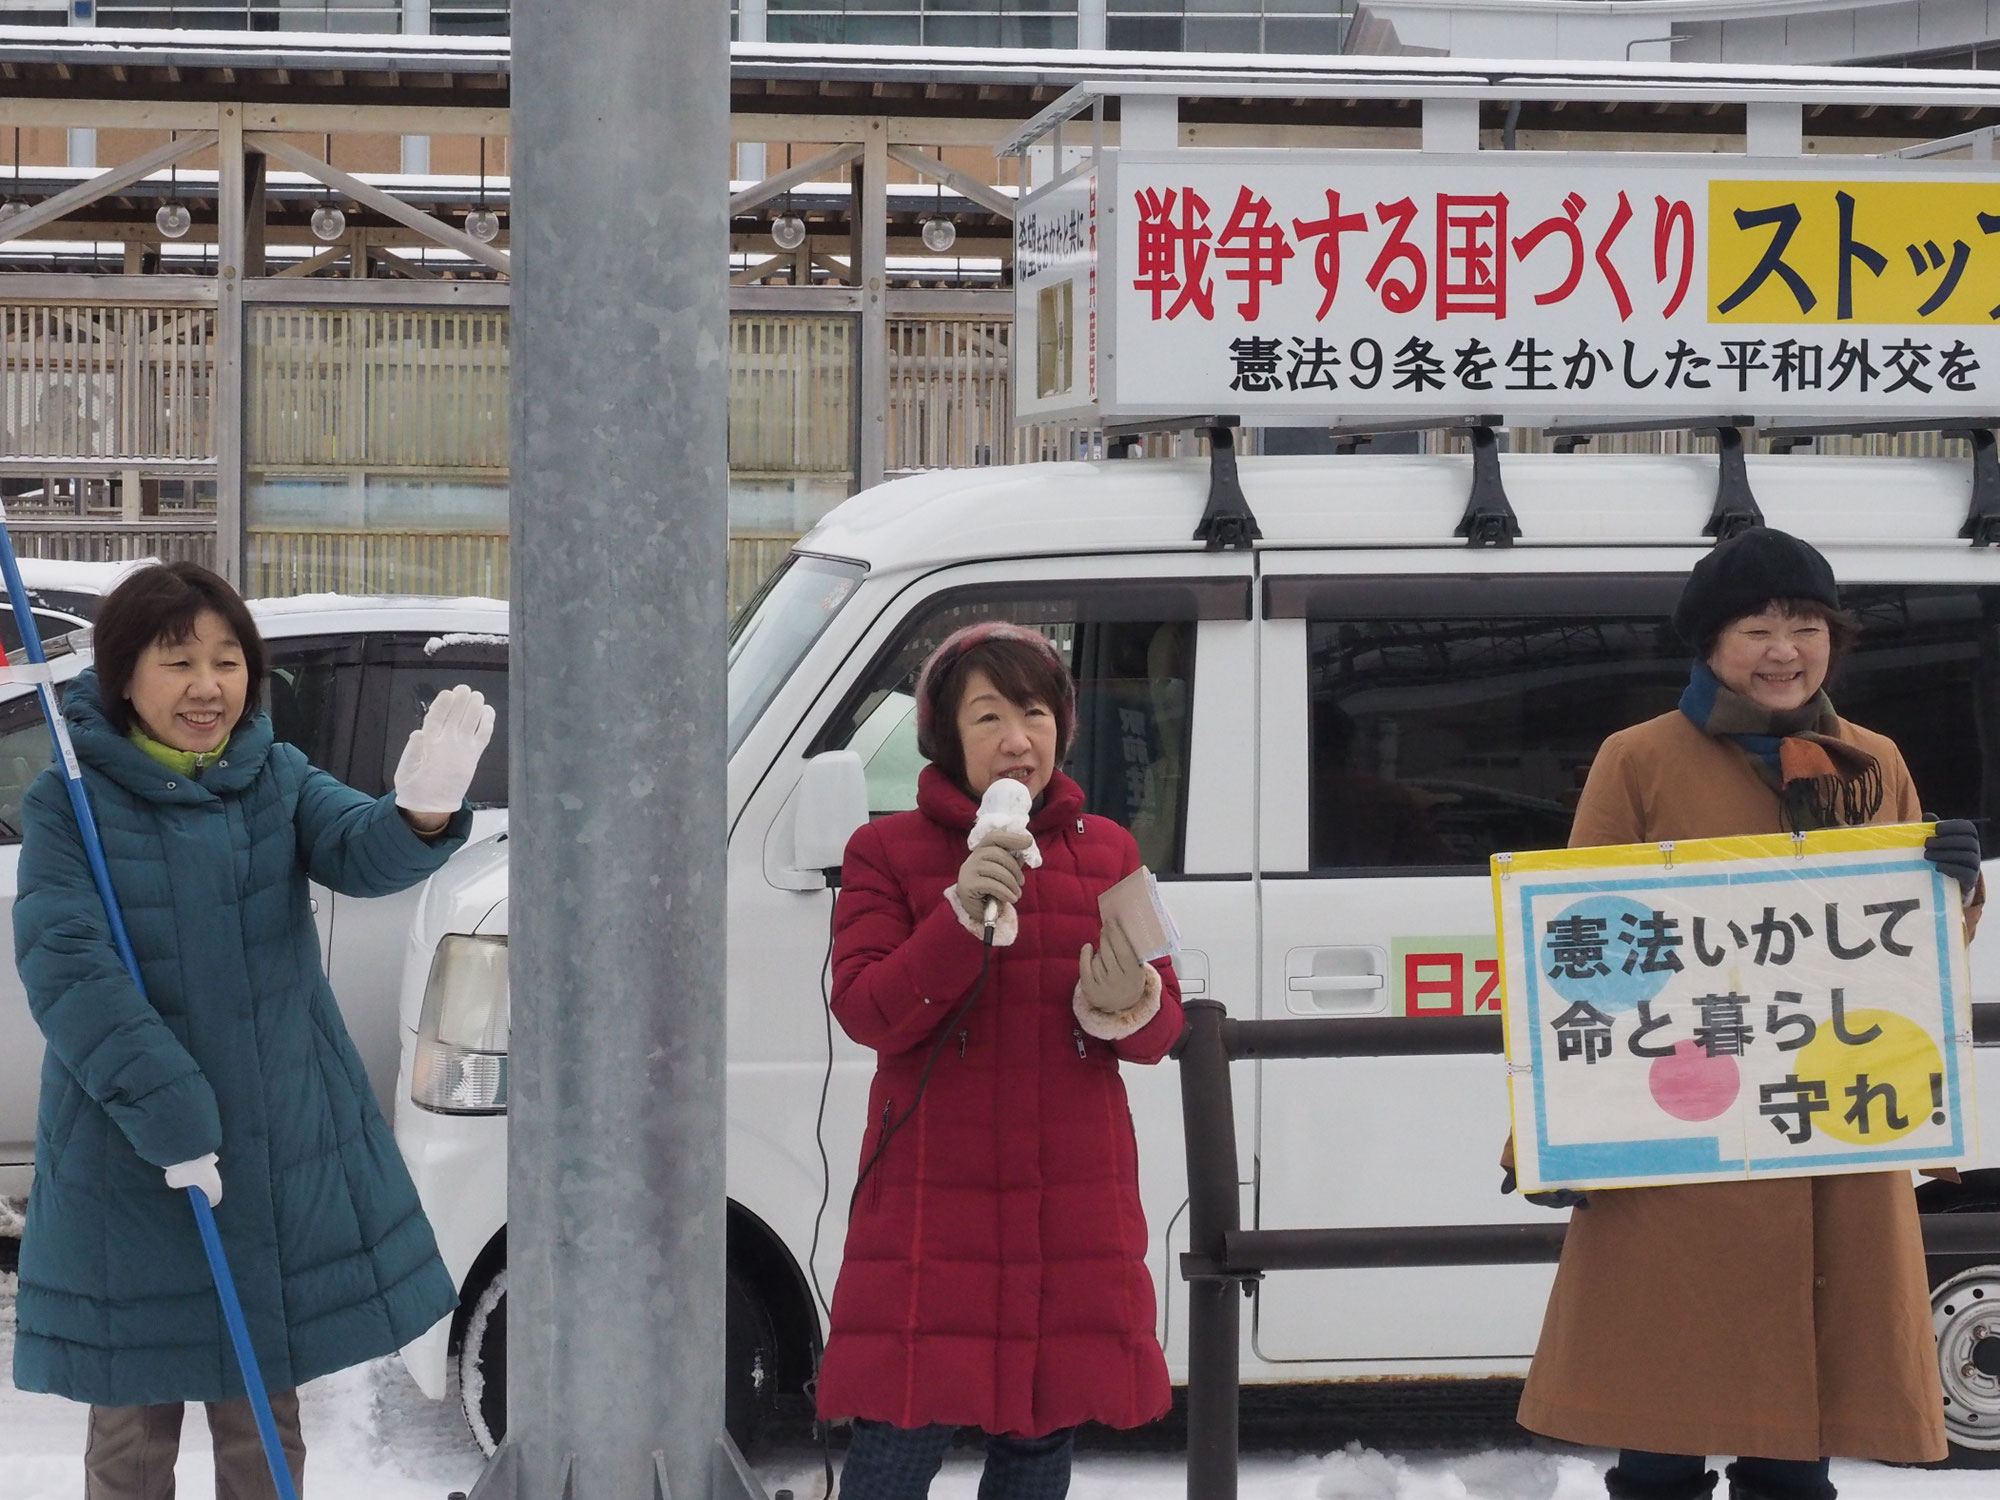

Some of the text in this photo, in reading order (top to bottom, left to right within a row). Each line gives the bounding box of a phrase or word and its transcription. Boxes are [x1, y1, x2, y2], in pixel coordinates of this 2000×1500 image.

[1133, 185, 2000, 322] 戦争する国づくり ストッ
[1229, 336, 1981, 394] 憲法9条を生かした平和外交を
[1546, 898, 1920, 979] 憲法いかして
[1550, 987, 1883, 1065] 命と暮らし
[1759, 1072, 1945, 1144] 守れ!
